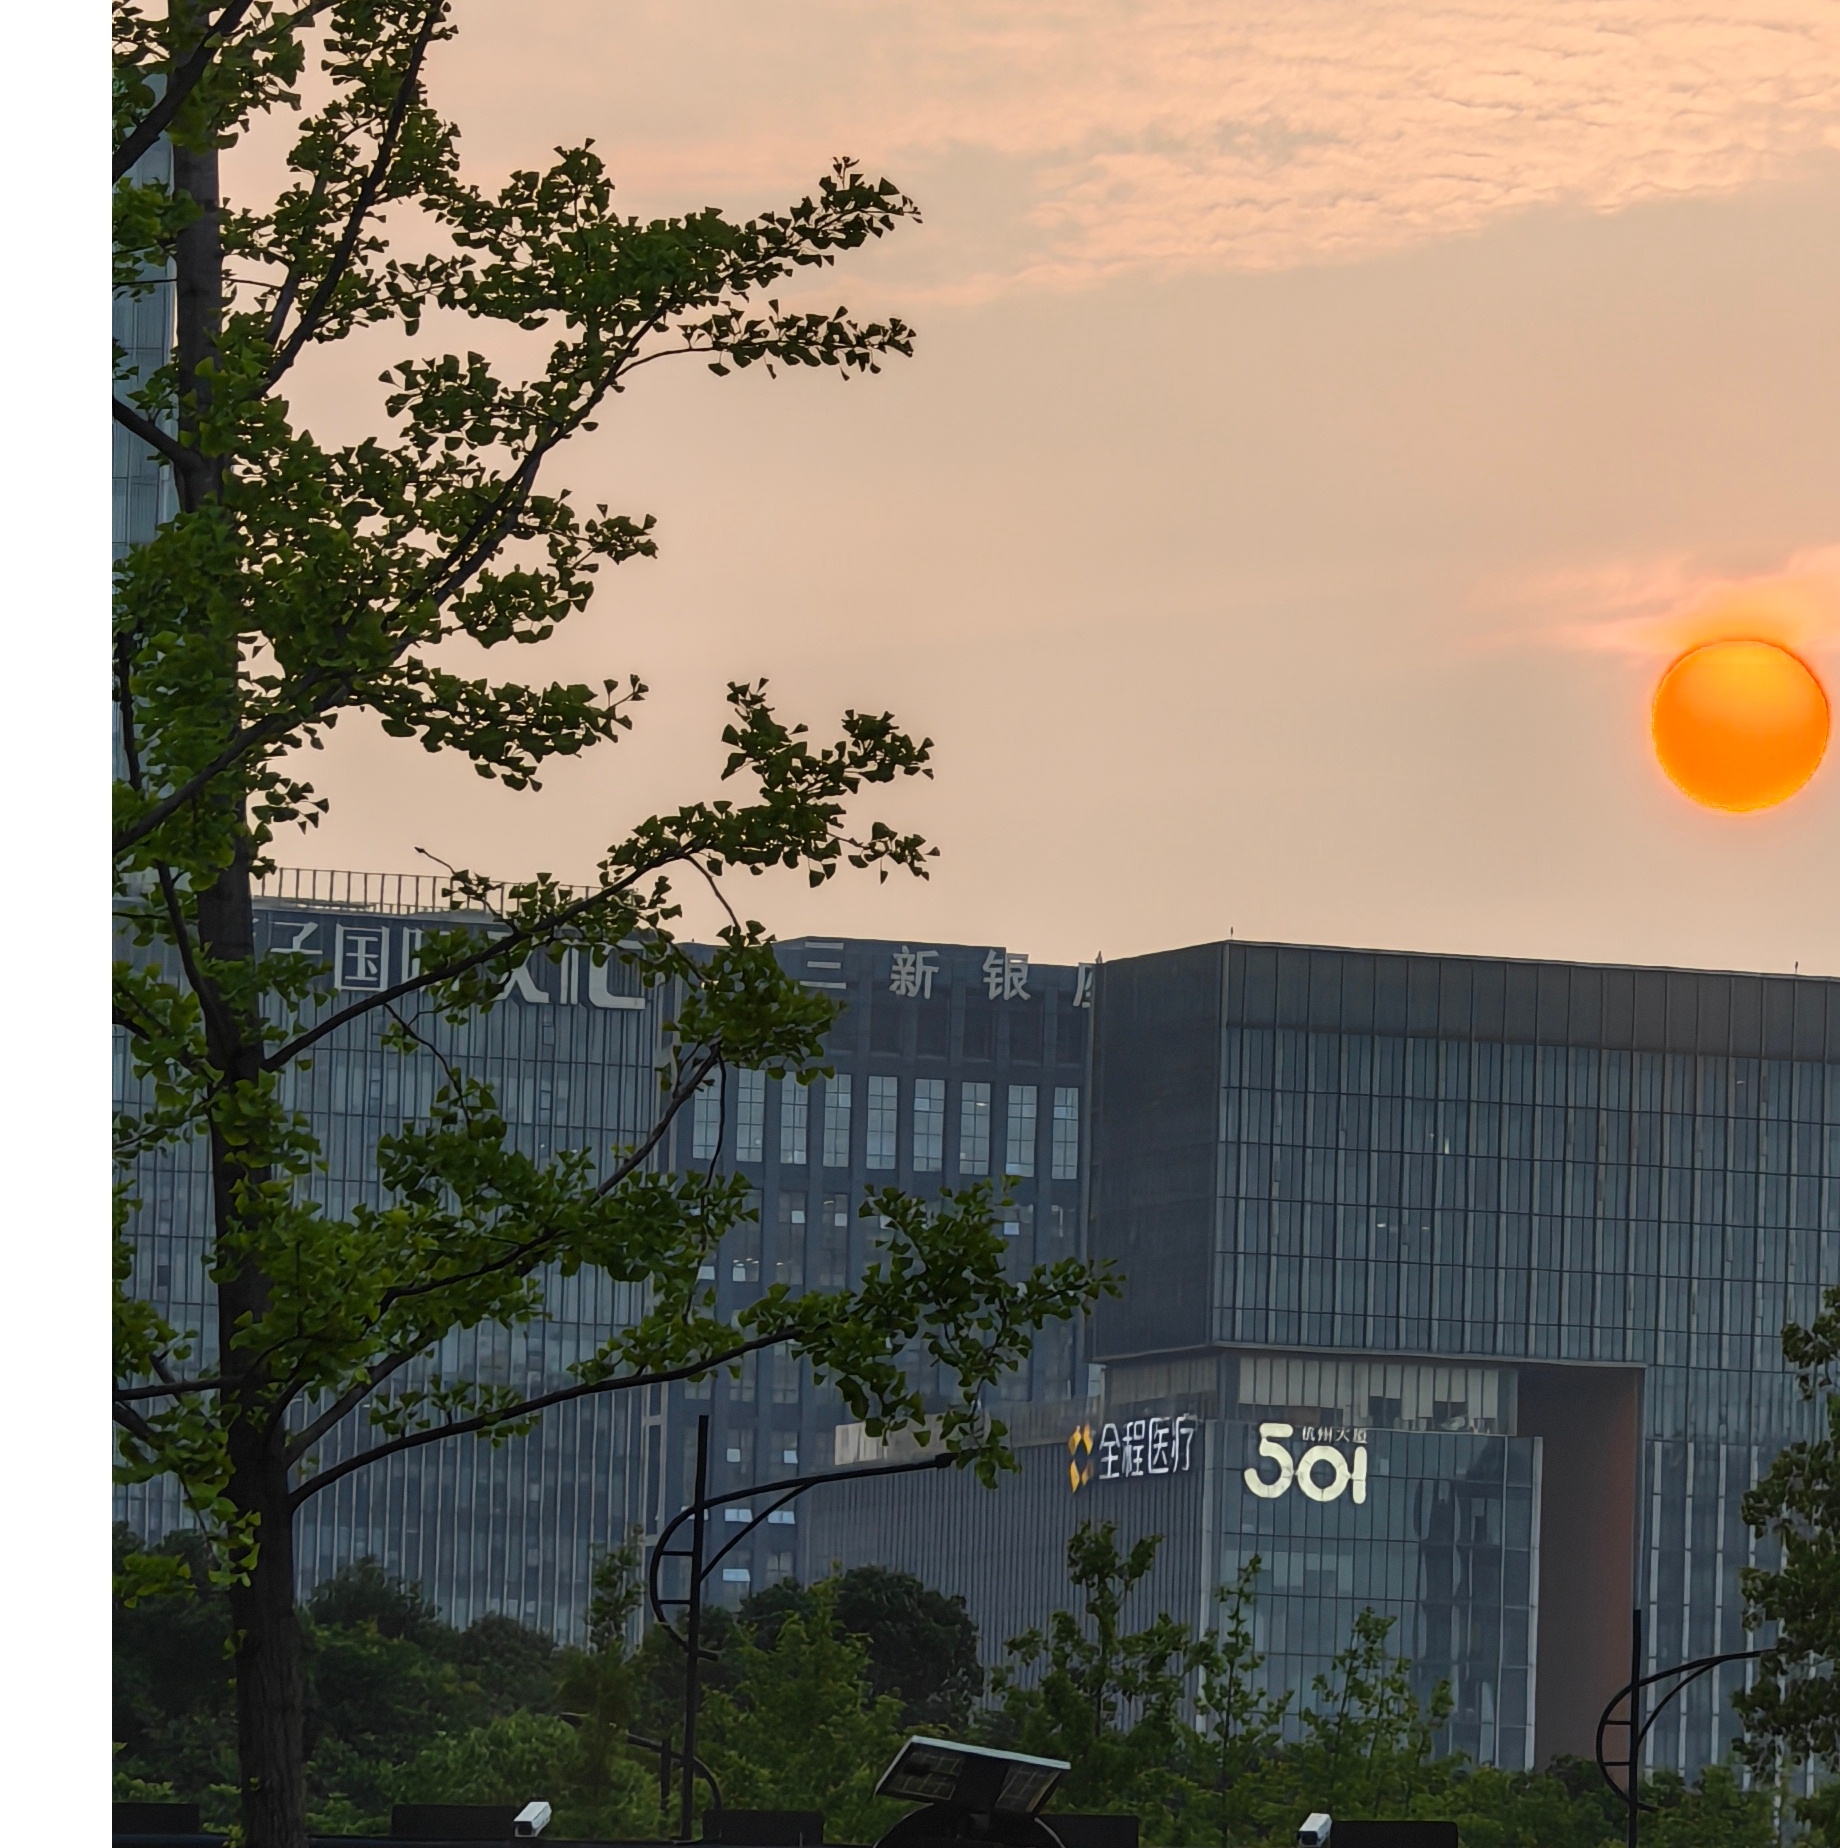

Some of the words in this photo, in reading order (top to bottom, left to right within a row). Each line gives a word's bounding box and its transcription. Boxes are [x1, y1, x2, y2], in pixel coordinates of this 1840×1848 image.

[1098, 1412, 1199, 1480] 全程医疗
[1242, 1422, 1368, 1505] 501
